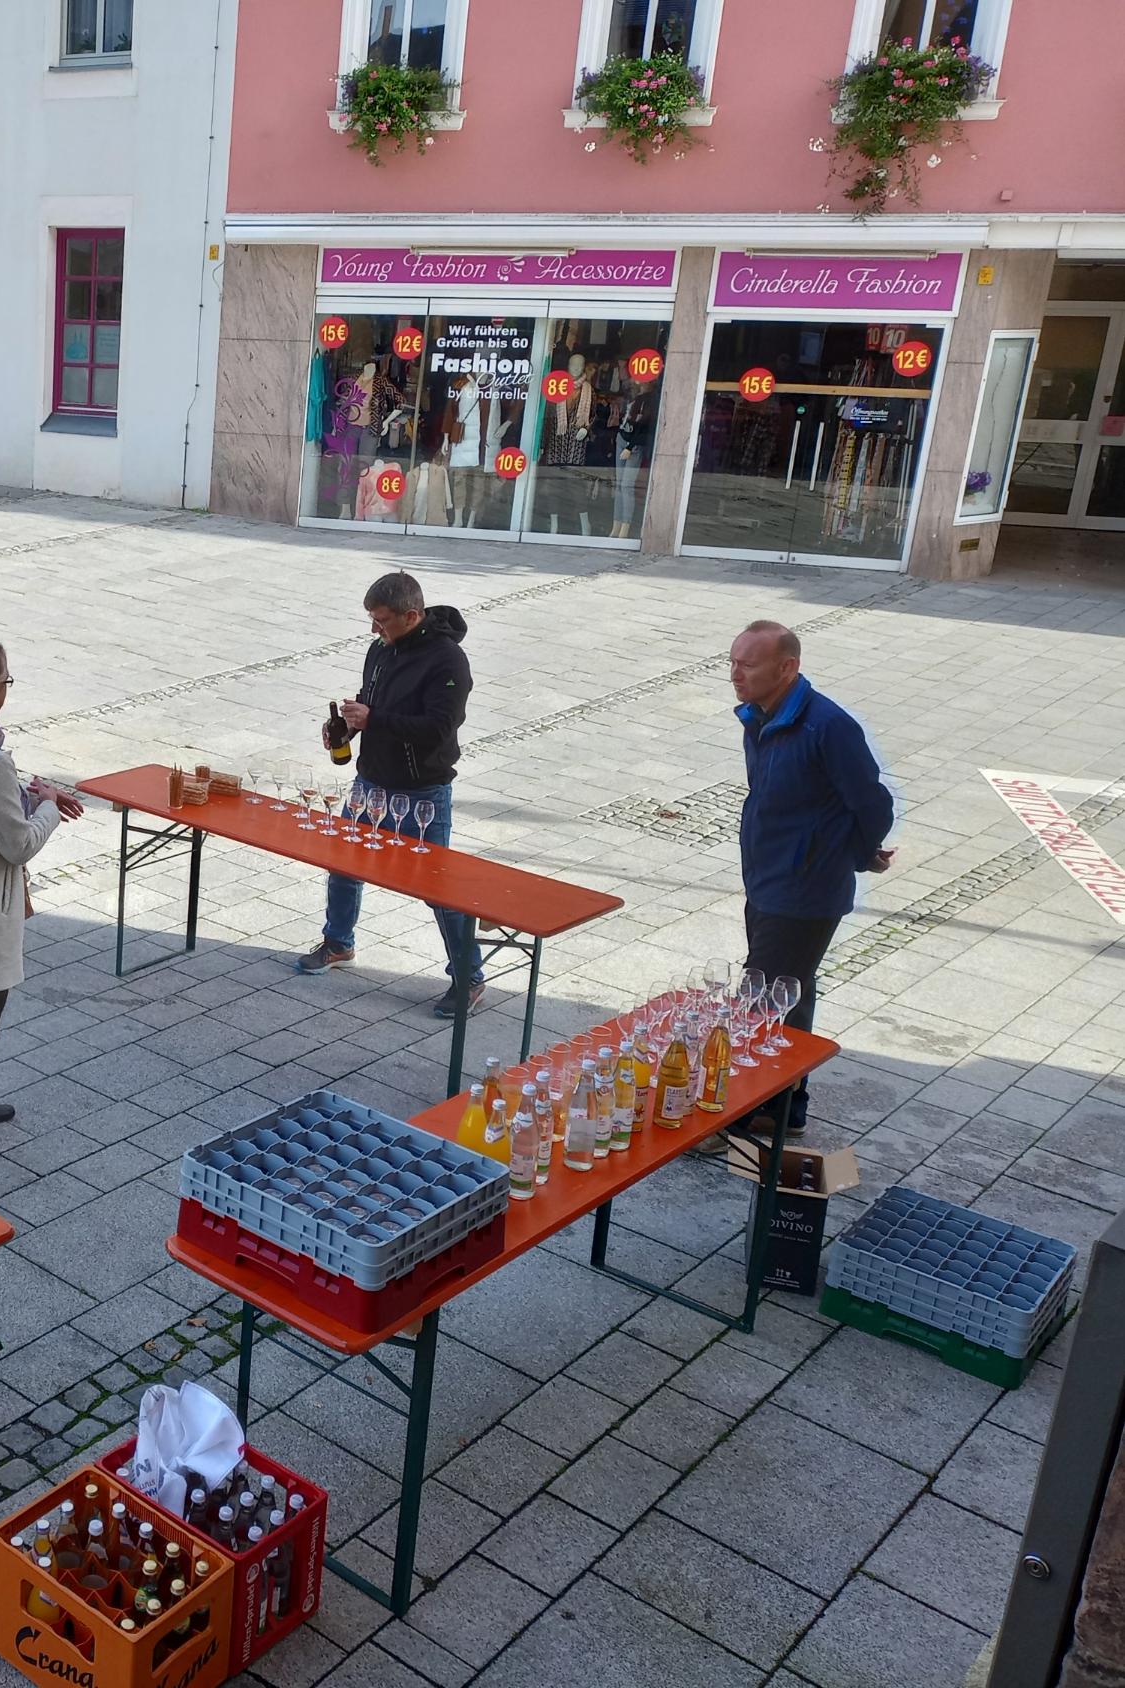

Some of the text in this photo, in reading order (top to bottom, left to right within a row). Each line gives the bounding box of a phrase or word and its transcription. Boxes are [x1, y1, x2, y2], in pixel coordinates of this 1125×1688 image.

[330, 252, 667, 282] Young Fashion Accessorize
[730, 266, 942, 295] Cinderella Fashion
[448, 325, 518, 337] Wir führen
[436, 337, 529, 348] Größen bis 60
[430, 352, 531, 374] Fashion
[476, 368, 535, 390] Outlet
[447, 387, 529, 401] by cinderella
